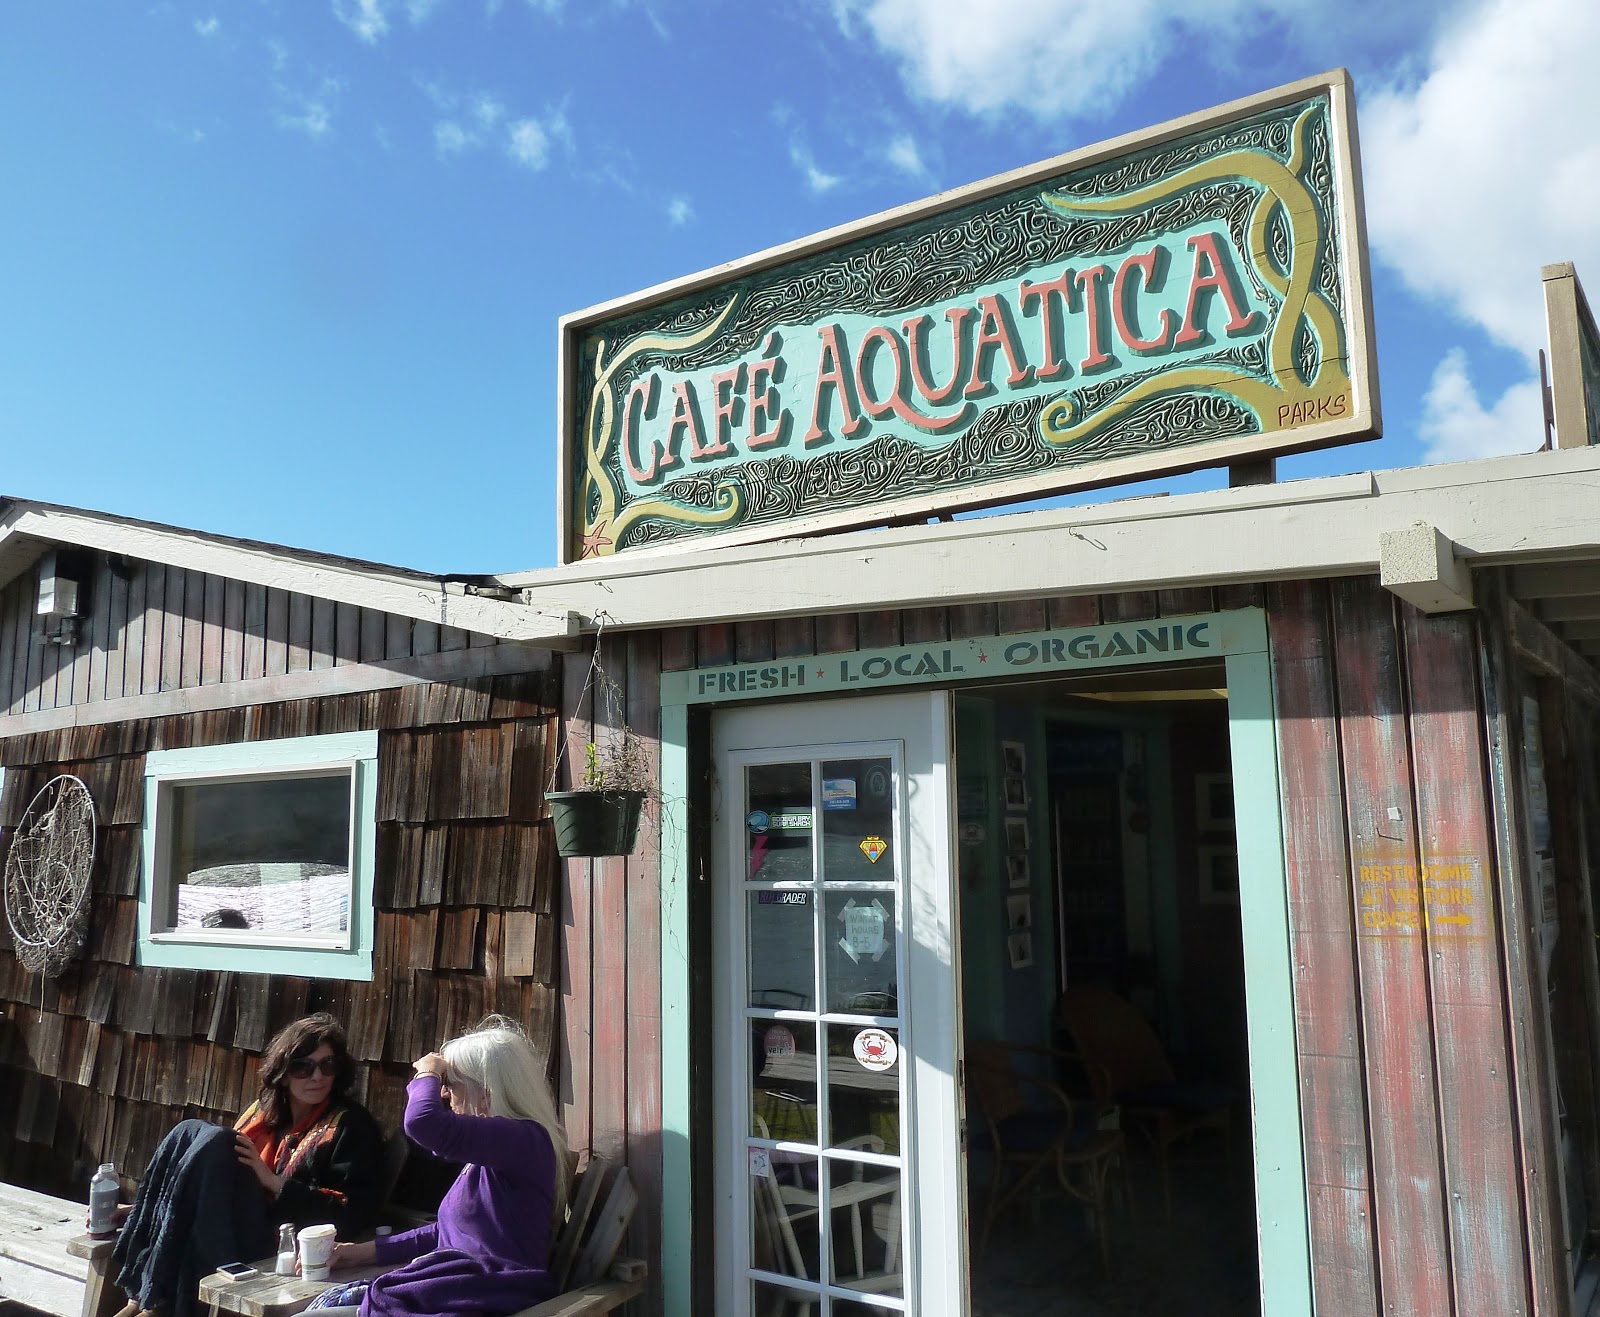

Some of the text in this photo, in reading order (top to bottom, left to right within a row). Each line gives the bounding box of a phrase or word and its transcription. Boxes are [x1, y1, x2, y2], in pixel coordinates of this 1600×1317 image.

[622, 233, 1257, 484] CAFÉ AQUATICA
[1278, 394, 1347, 427] PARKS
[698, 622, 1210, 695] FRESH LOCAL ORGANIC
[1360, 864, 1472, 882] RESTROOMS
[1362, 888, 1384, 905] AT
